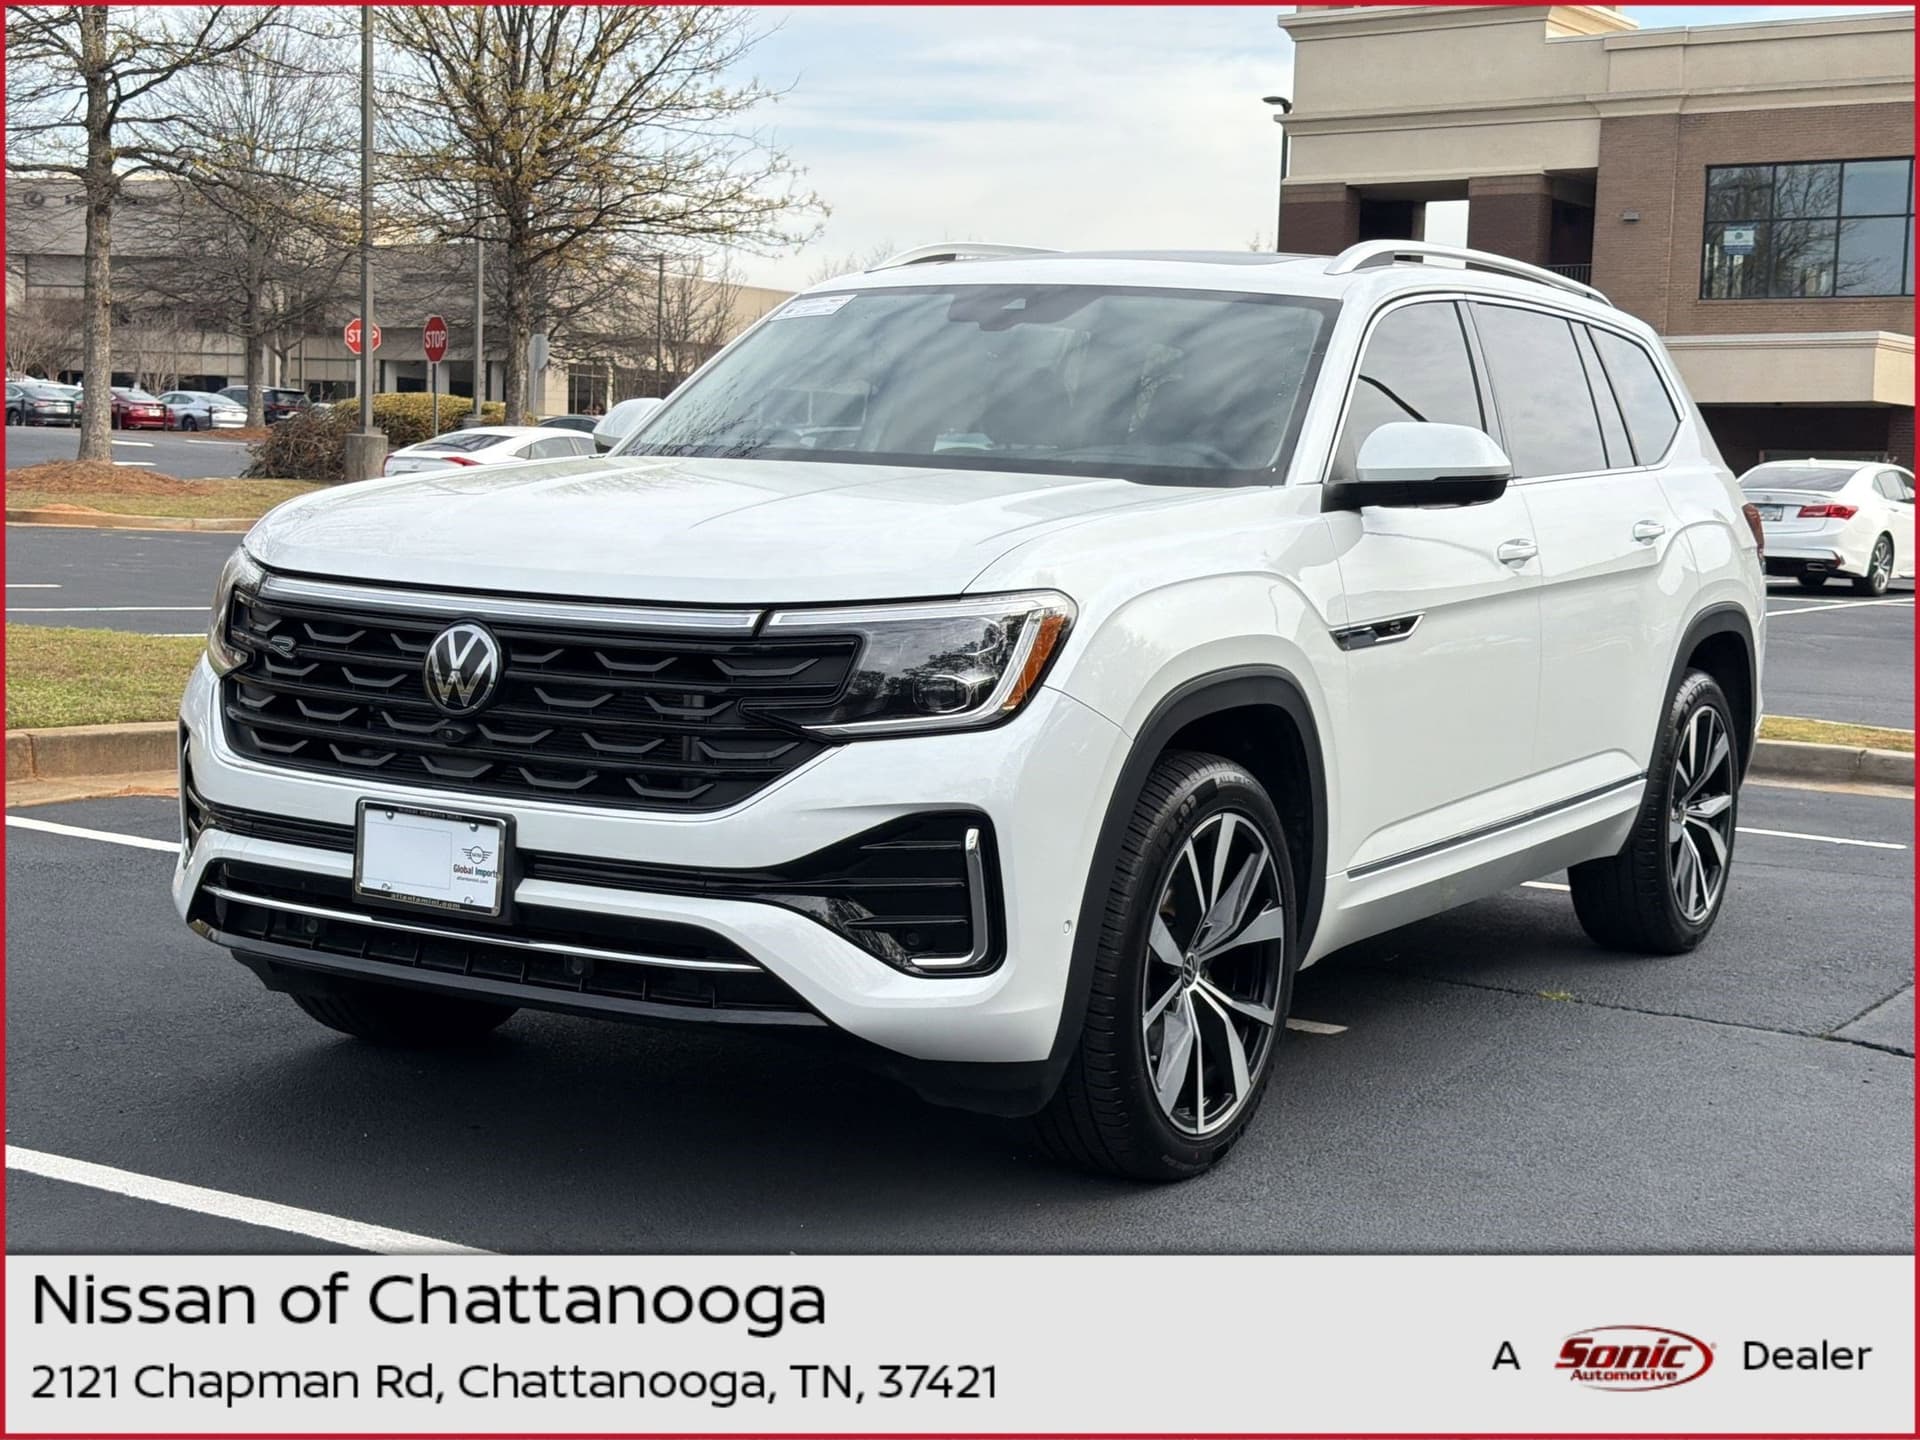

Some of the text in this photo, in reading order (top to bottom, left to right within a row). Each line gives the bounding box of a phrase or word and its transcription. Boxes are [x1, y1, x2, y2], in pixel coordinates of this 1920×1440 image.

[348, 330, 377, 343] STP
[426, 331, 446, 348] STOP
[453, 863, 474, 875] Global
